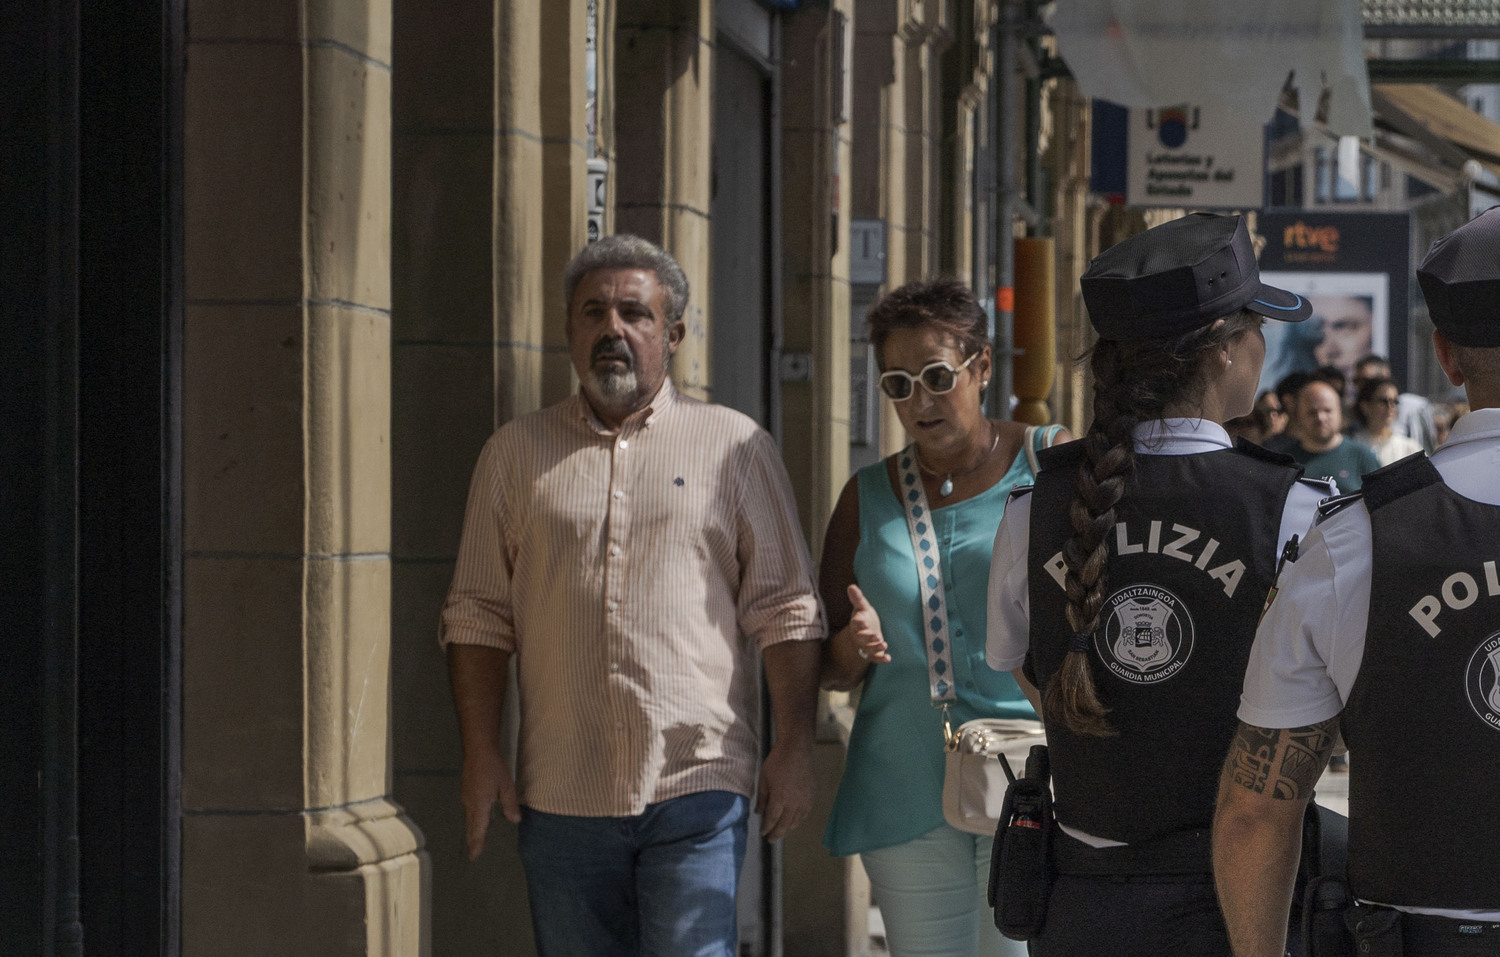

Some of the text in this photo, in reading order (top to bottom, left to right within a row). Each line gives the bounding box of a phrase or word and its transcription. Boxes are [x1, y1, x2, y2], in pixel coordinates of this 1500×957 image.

[1283, 221, 1340, 251] rtve
[1043, 520, 1246, 598] PLIZIA
[1111, 588, 1175, 607] UDALTZAINGOA
[1127, 649, 1136, 659] SAN
[1110, 660, 1183, 681] GUARDIA MUNICIPAL
